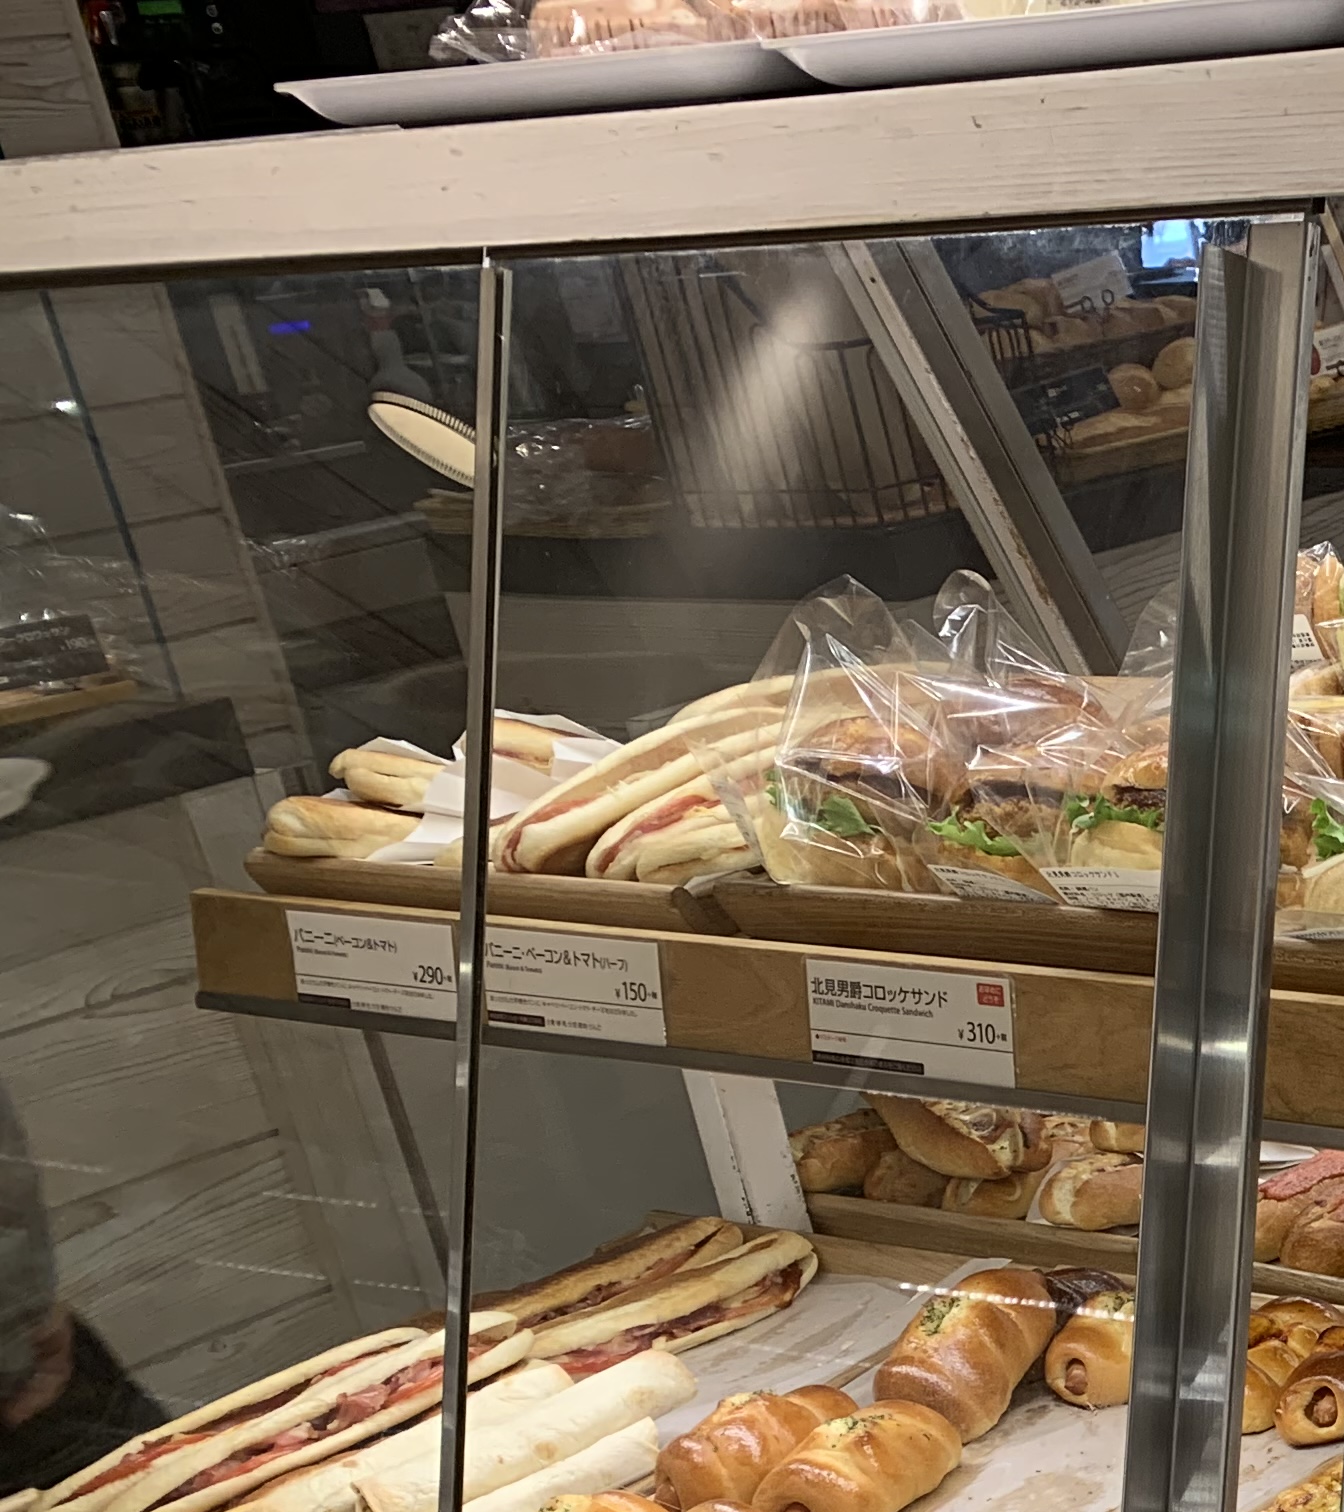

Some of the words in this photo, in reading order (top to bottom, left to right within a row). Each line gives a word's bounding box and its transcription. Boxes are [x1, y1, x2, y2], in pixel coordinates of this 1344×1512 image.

[810, 977, 948, 1008] 北見男爵コロッケサンド
[812, 997, 835, 1007] KITAMI
[835, 999, 867, 1011] Danshaku
[867, 1003, 901, 1015] Croquette
[901, 1006, 934, 1018] Sandwich
